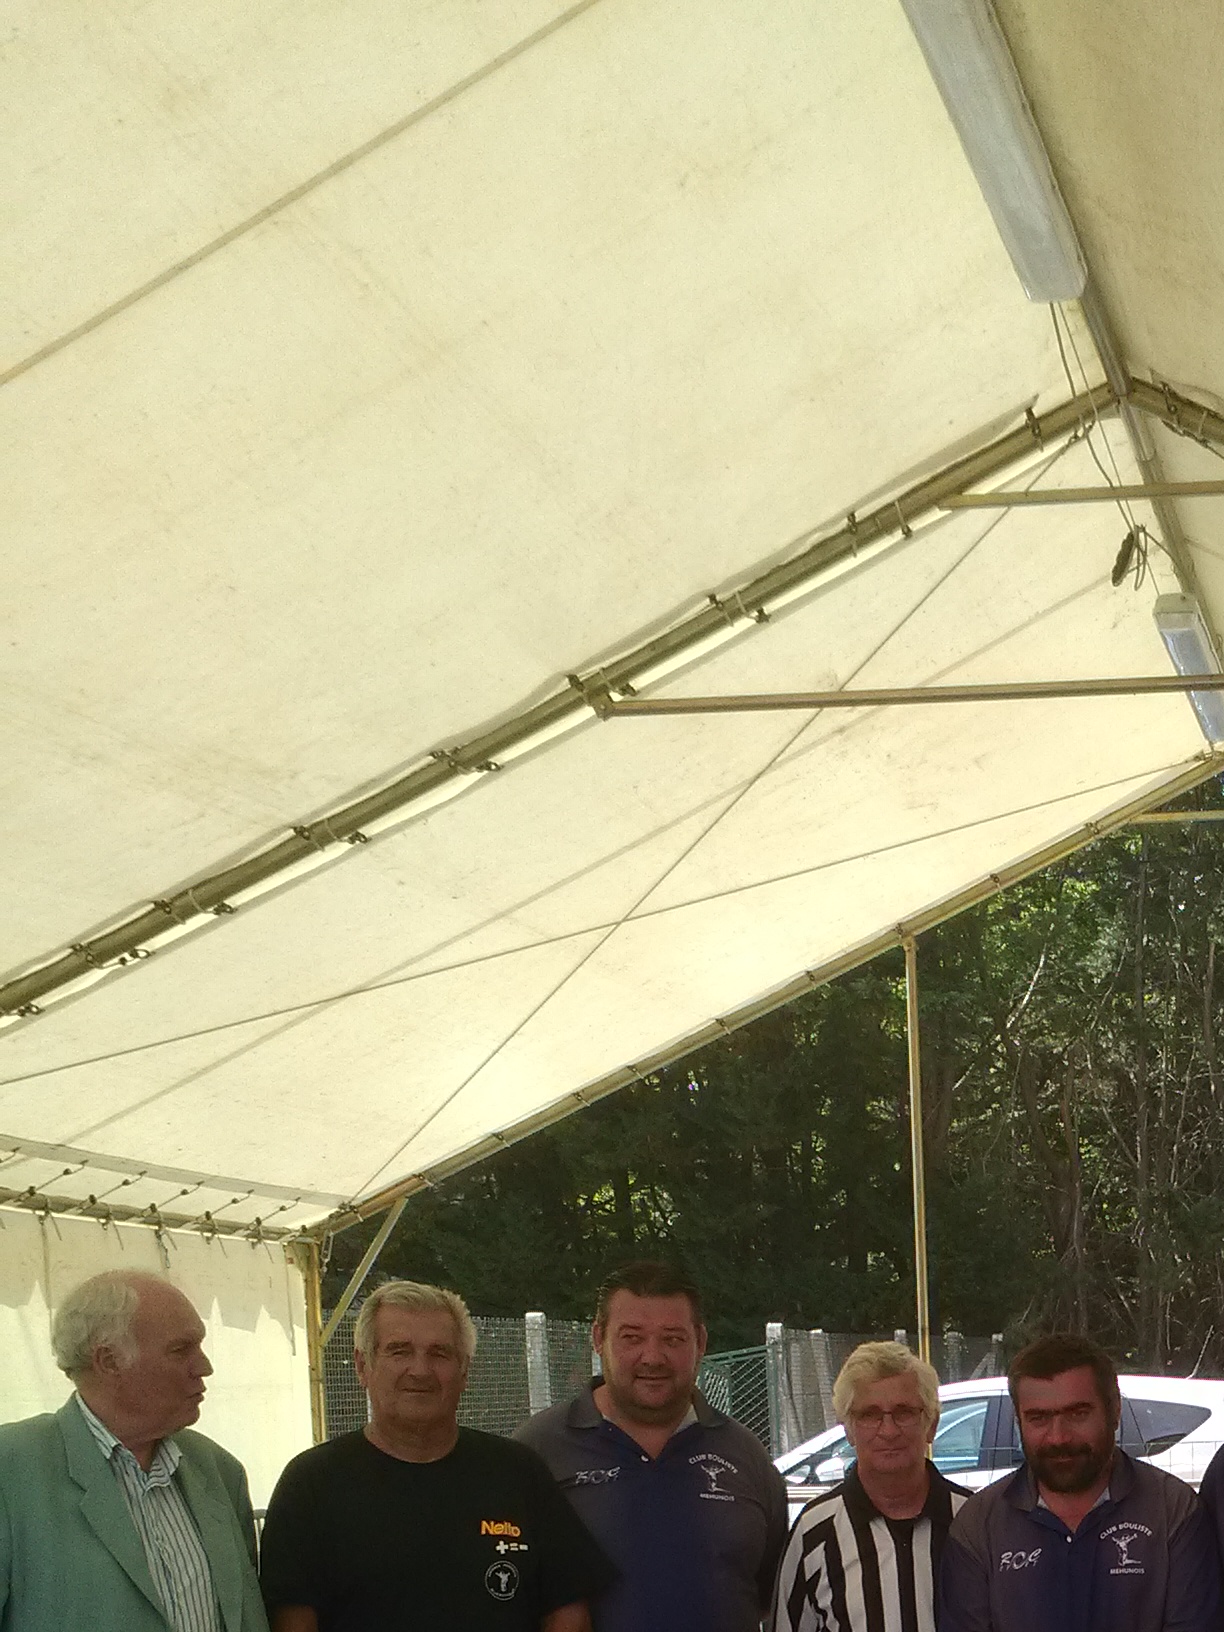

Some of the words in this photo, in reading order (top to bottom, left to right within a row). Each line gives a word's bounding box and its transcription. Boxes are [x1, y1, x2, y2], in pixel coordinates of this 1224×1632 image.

[1100, 1527, 1118, 1540] CLUB
[1118, 1522, 1153, 1538] BOULISTE
[1109, 1567, 1145, 1575] MEHUNOIS
